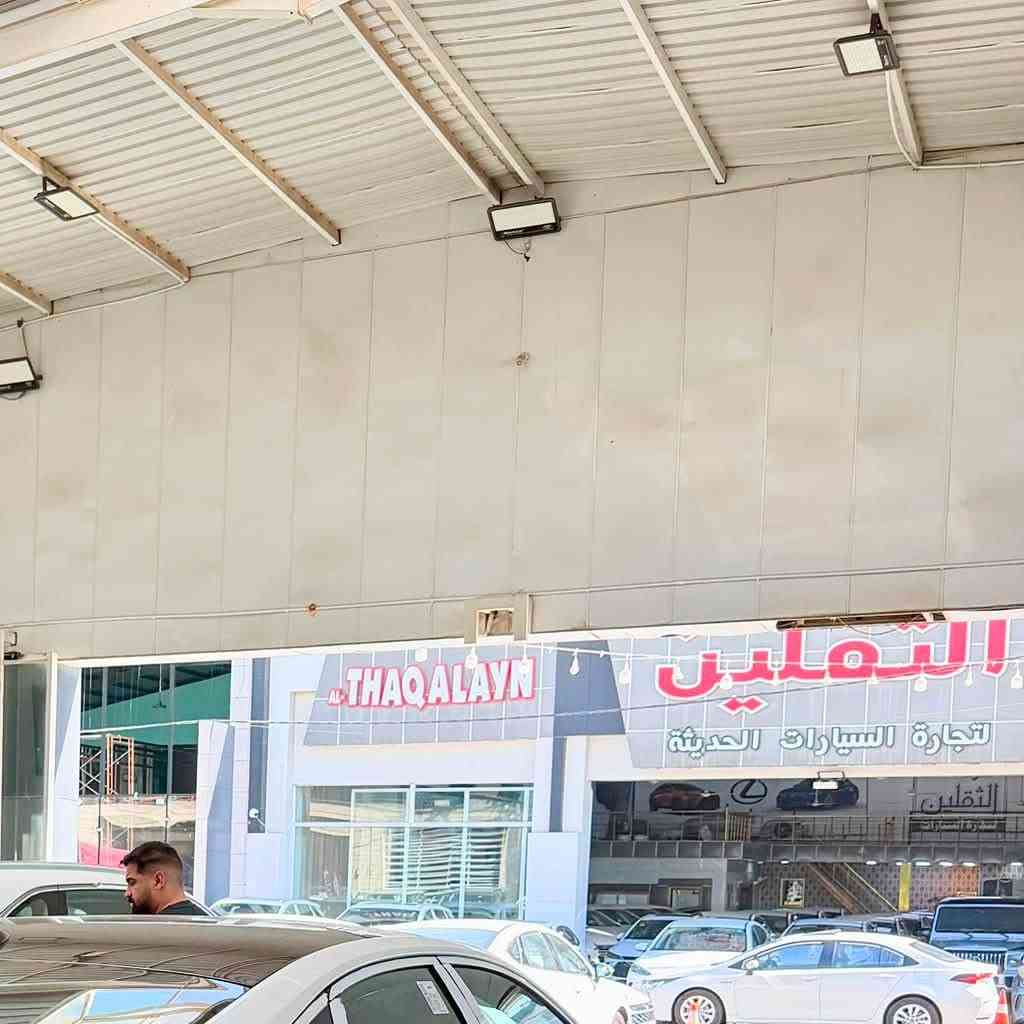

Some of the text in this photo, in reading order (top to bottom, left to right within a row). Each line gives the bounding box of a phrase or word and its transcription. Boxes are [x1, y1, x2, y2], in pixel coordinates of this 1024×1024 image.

[667, 721, 992, 758] لتجارة السيارات الحديثة
[920, 782, 999, 815] الثقلين
